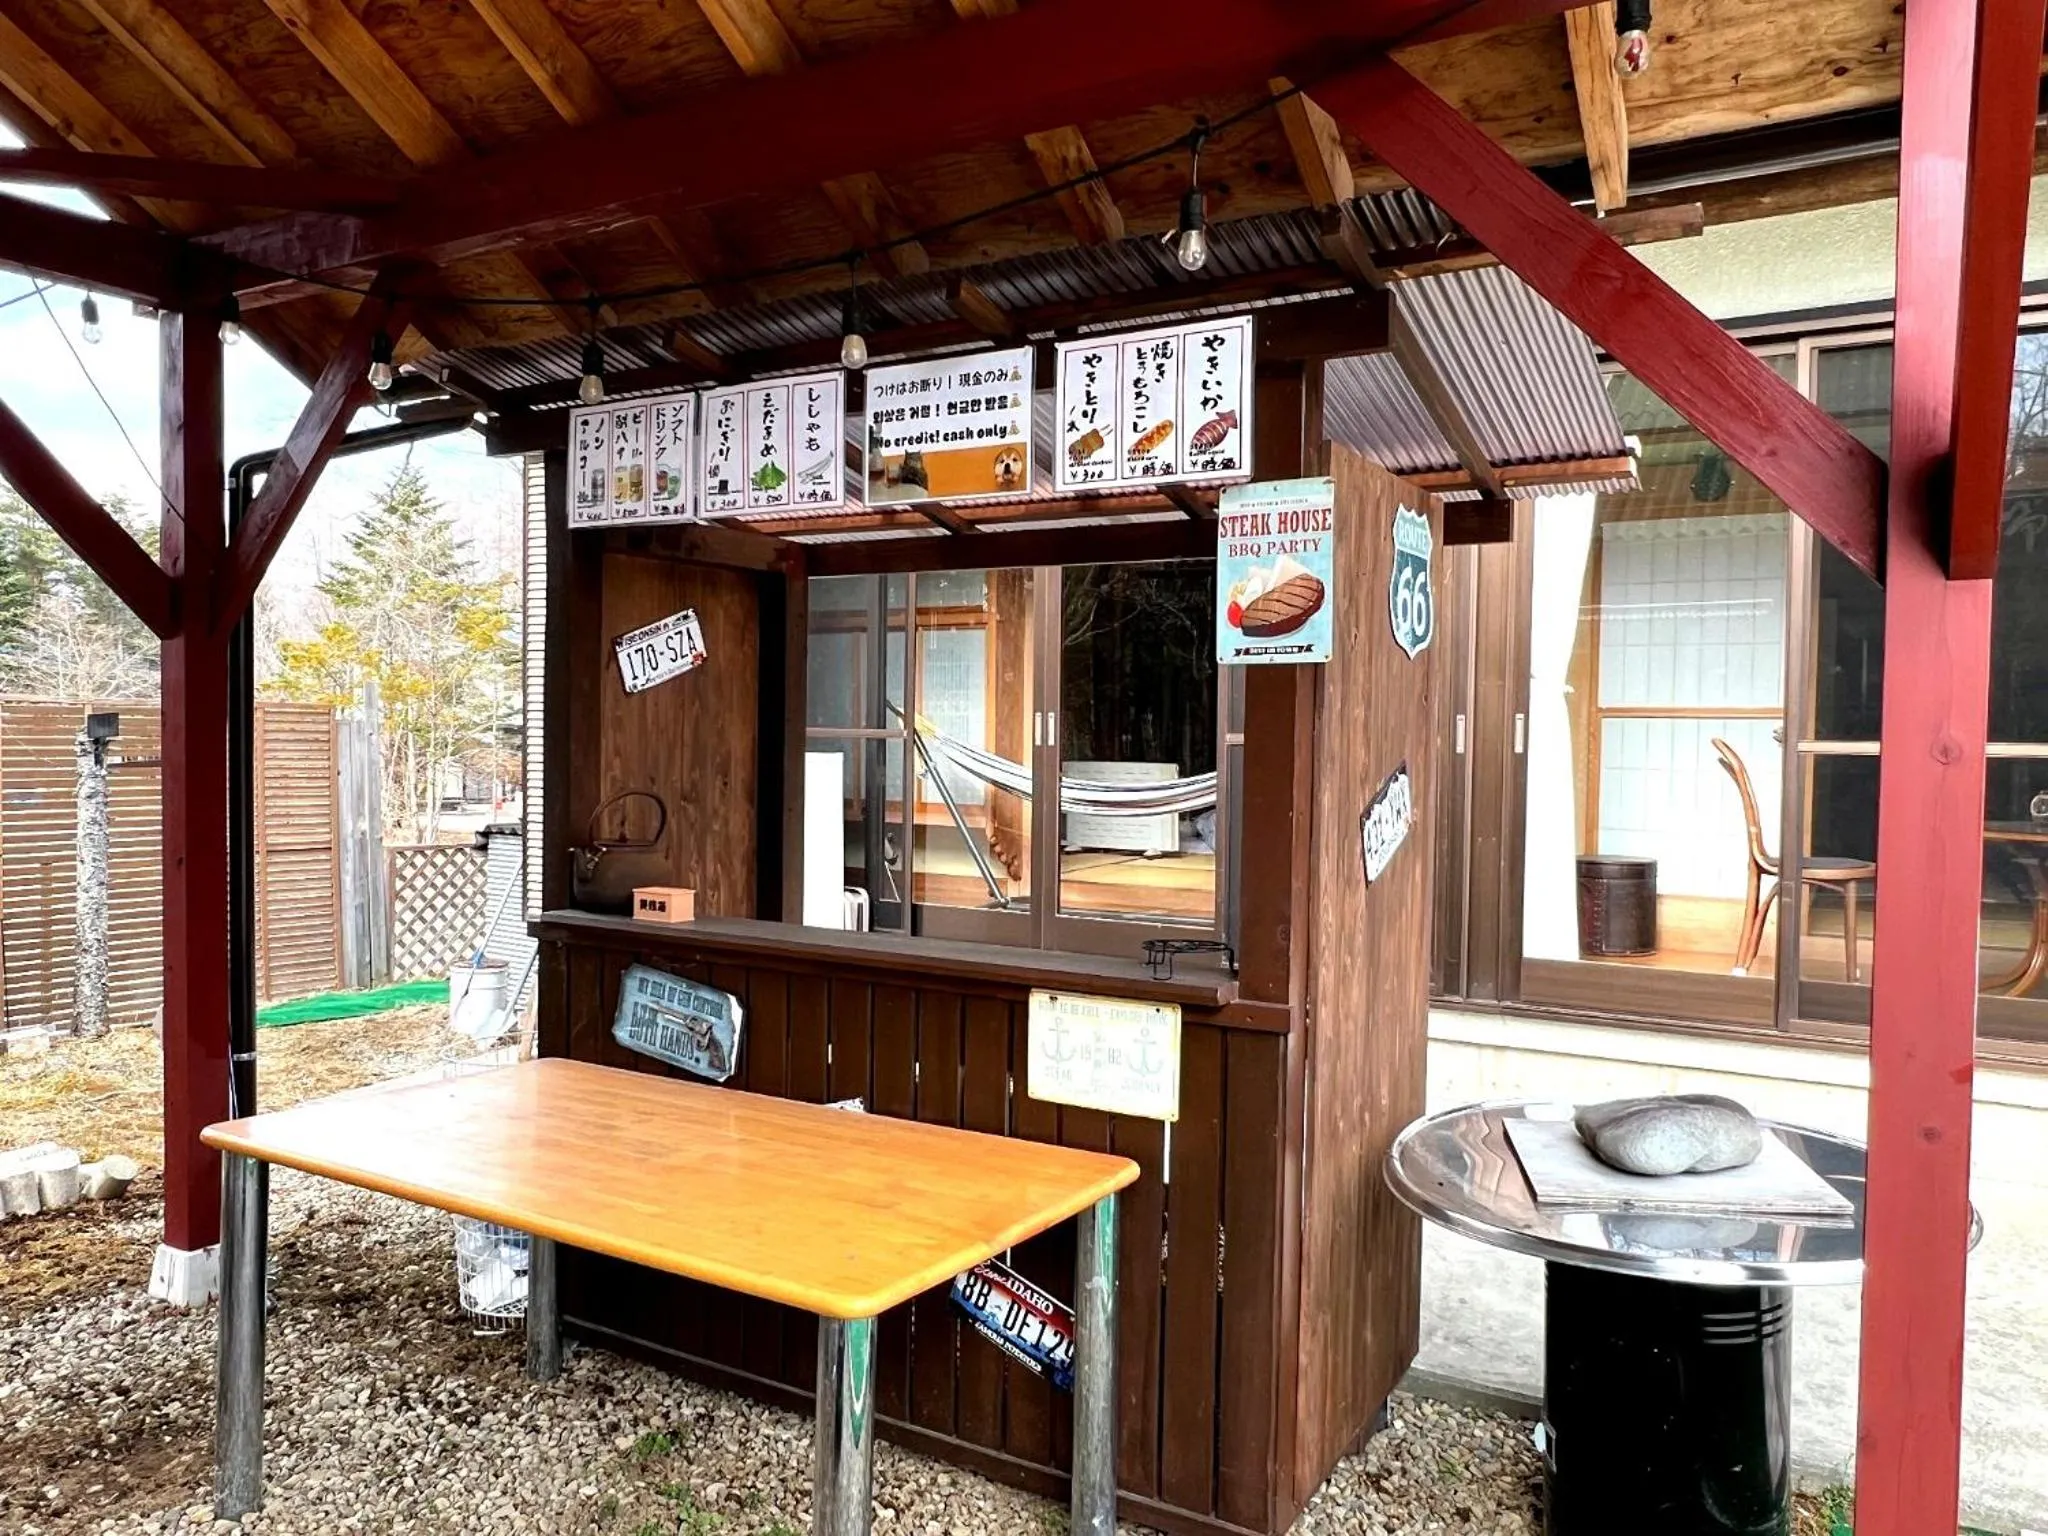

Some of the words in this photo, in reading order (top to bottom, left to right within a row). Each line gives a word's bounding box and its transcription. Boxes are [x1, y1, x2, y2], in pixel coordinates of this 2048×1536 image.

[1082, 353, 1102, 424] やきとり
[1132, 347, 1150, 433] とうもろこし
[1200, 334, 1226, 411] やきいか
[632, 410, 645, 458] ビール
[655, 408, 667, 460] ドリンク
[671, 405, 684, 445] ソフト
[718, 399, 735, 461] おにぎり
[760, 392, 780, 457] えだまめ
[805, 388, 821, 451] ししゃも
[894, 430, 940, 447] credit!
[943, 427, 974, 442] cash
[977, 424, 1008, 439] only
[1220, 513, 1272, 539] STEAK
[1277, 508, 1332, 535] HOUSE
[1228, 543, 1261, 558] BBQ
[1266, 538, 1322, 555] PARTY
[1399, 520, 1427, 551] ROUTE
[1397, 567, 1427, 637] 66
[615, 623, 662, 649] WISCONSIN
[1004, 1276, 1054, 1316] IDAHO
